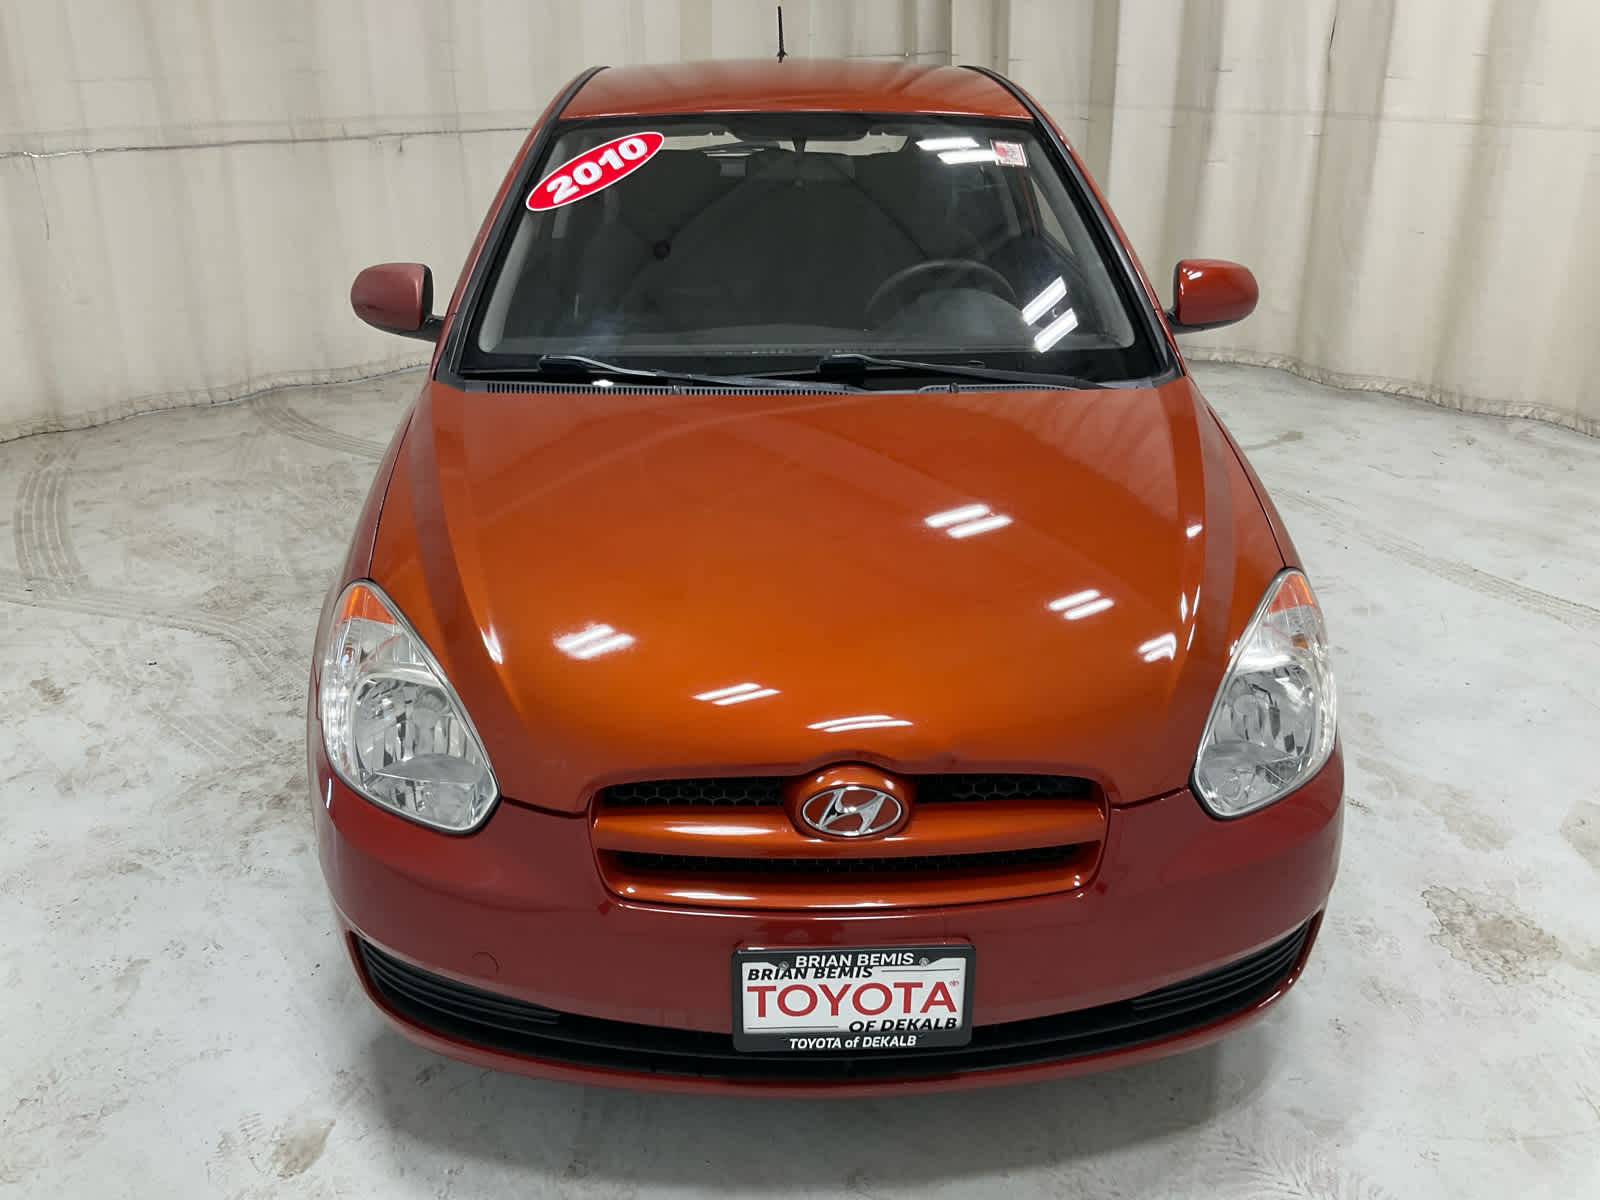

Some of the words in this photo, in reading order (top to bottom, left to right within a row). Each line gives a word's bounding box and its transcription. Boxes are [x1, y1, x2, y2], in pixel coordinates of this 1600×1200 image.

[546, 137, 648, 204] 2010
[795, 954, 852, 969] BRIAN
[857, 952, 914, 967] BEMIS
[747, 967, 807, 981] BRIAN
[813, 967, 873, 979] BEMIS
[746, 981, 957, 1017] TOYOTA
[848, 1019, 877, 1033] OF
[881, 1017, 957, 1032] DEKALB
[789, 1036, 842, 1050] TOYOTA
[844, 1036, 861, 1049] of
[862, 1035, 917, 1048] DEKALB
